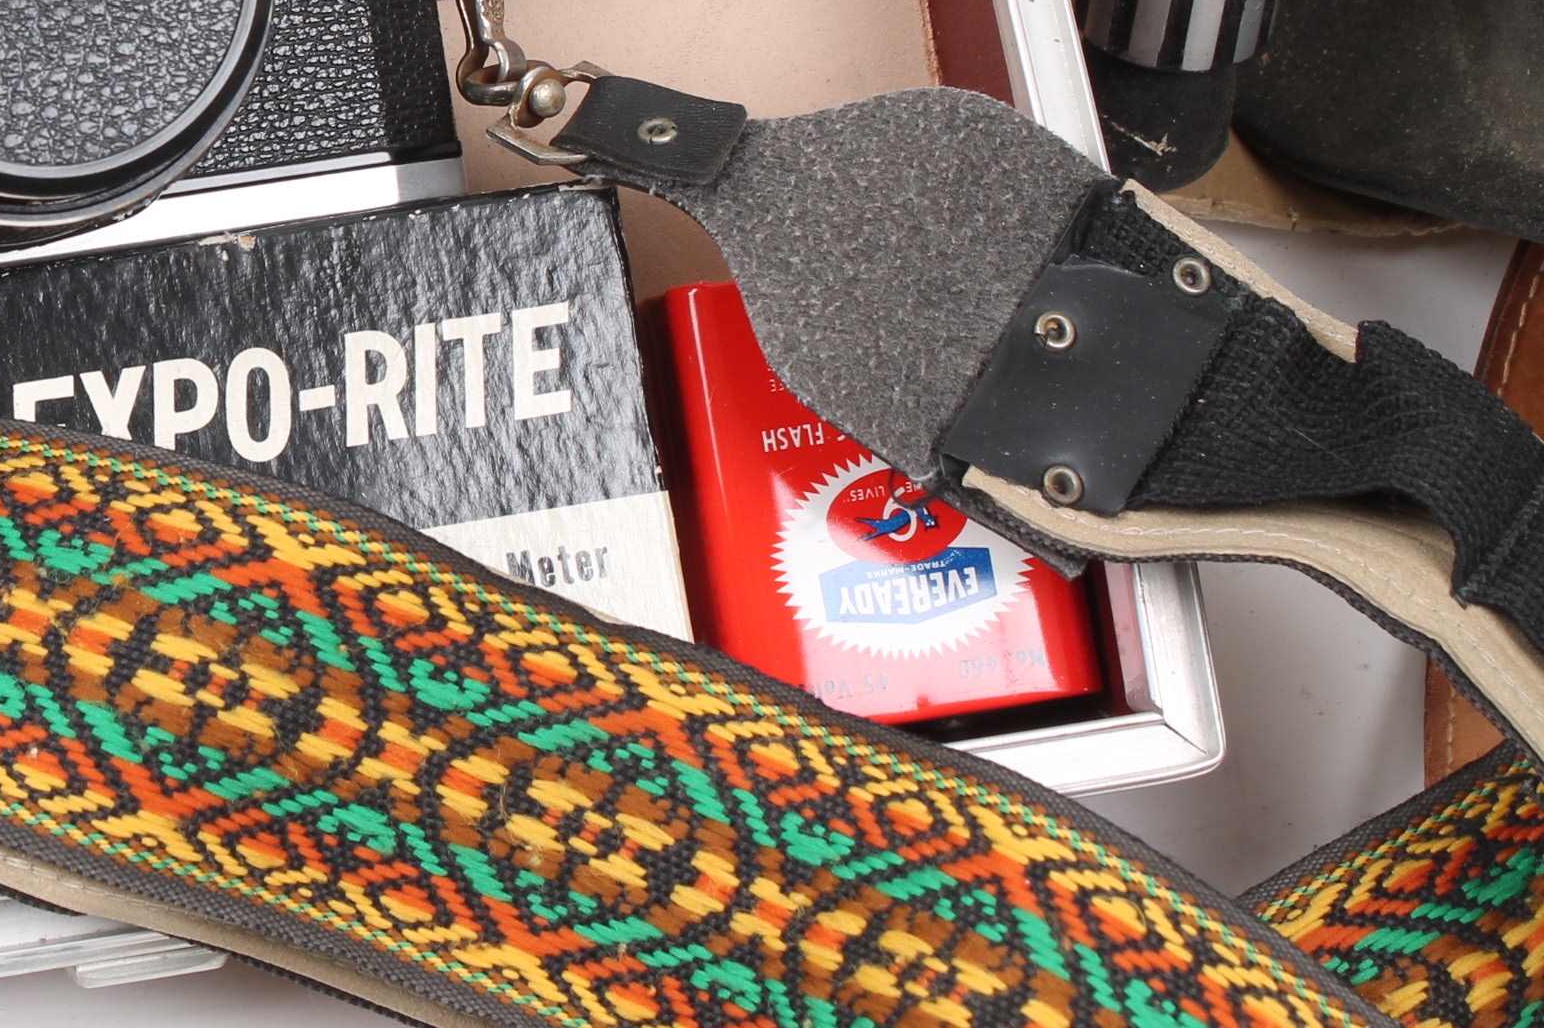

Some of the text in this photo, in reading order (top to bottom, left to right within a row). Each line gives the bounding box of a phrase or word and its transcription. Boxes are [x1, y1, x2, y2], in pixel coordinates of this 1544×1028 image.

[761, 422, 825, 453] FLASH
[505, 545, 608, 588] Meter
[866, 560, 946, 580] TRADE-MARKS
[839, 566, 980, 616] EVEREADY
